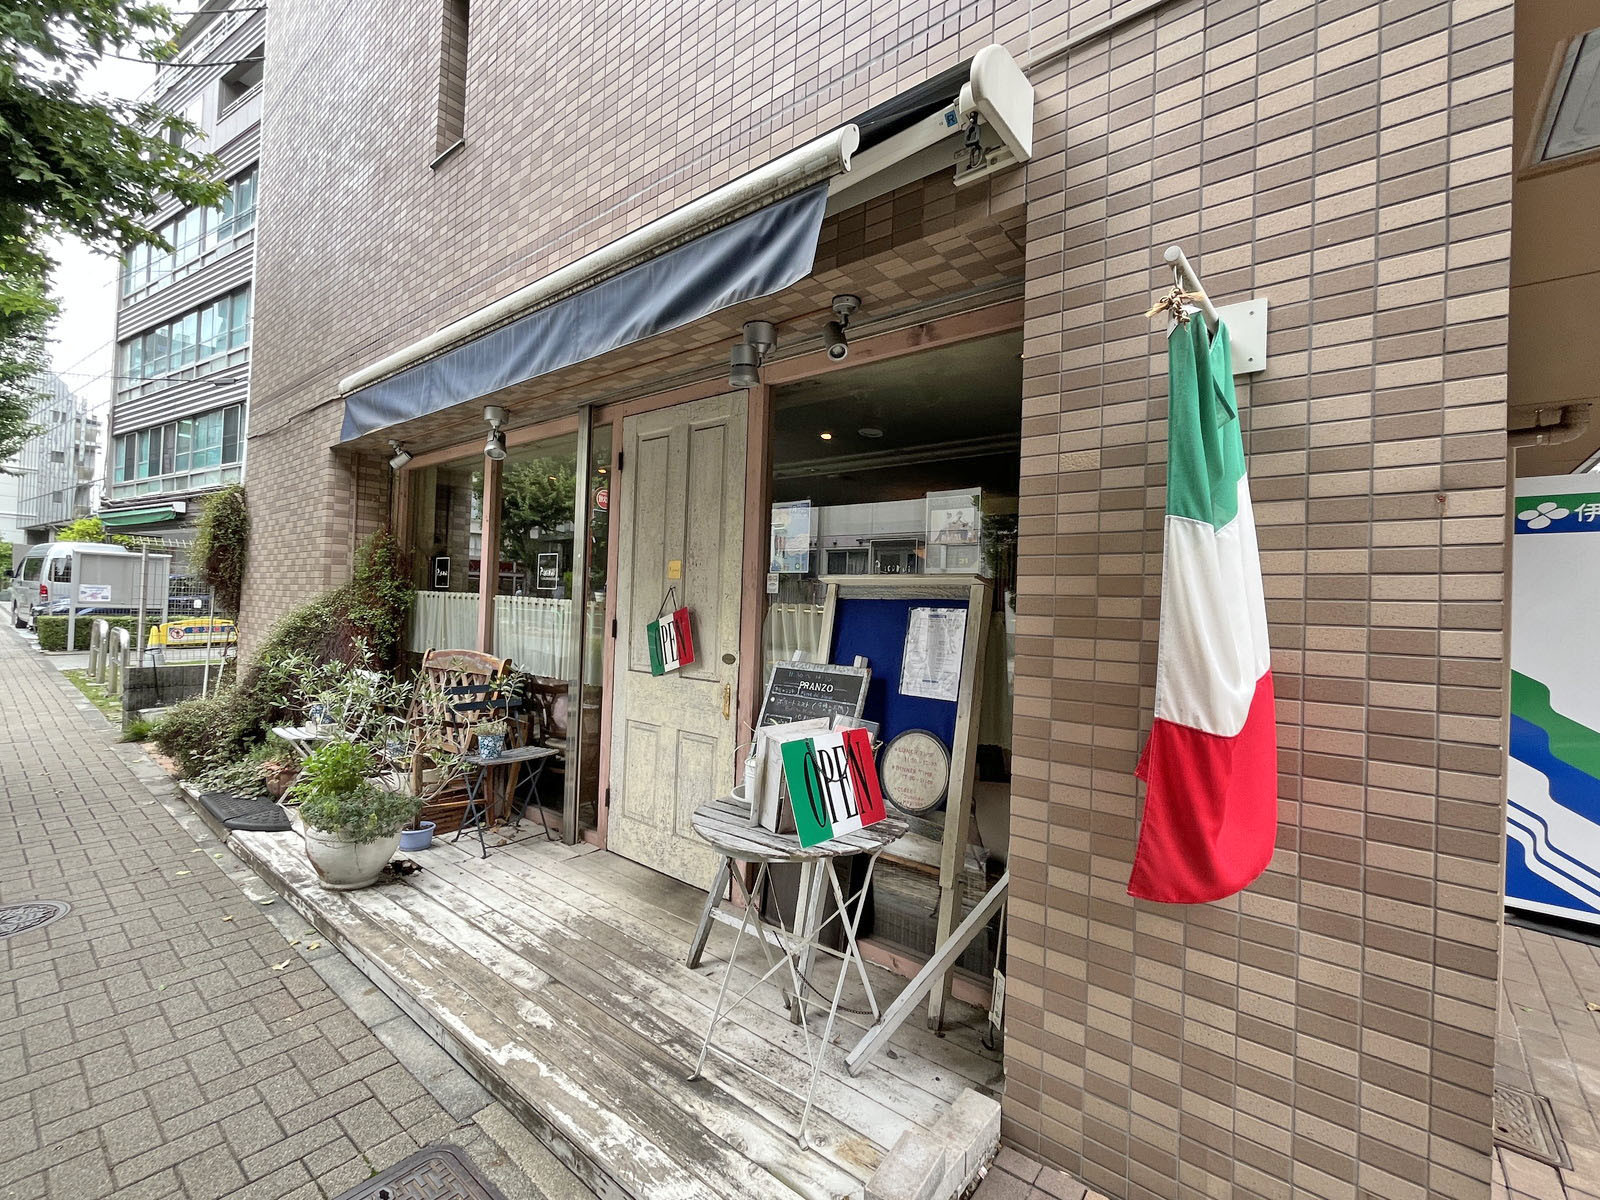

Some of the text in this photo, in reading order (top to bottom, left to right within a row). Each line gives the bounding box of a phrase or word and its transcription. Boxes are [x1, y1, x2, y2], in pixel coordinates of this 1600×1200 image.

[947, 114, 956, 124] R
[654, 615, 688, 667] OPEN
[799, 680, 834, 693] PRANZO
[803, 740, 874, 828] OPEN
